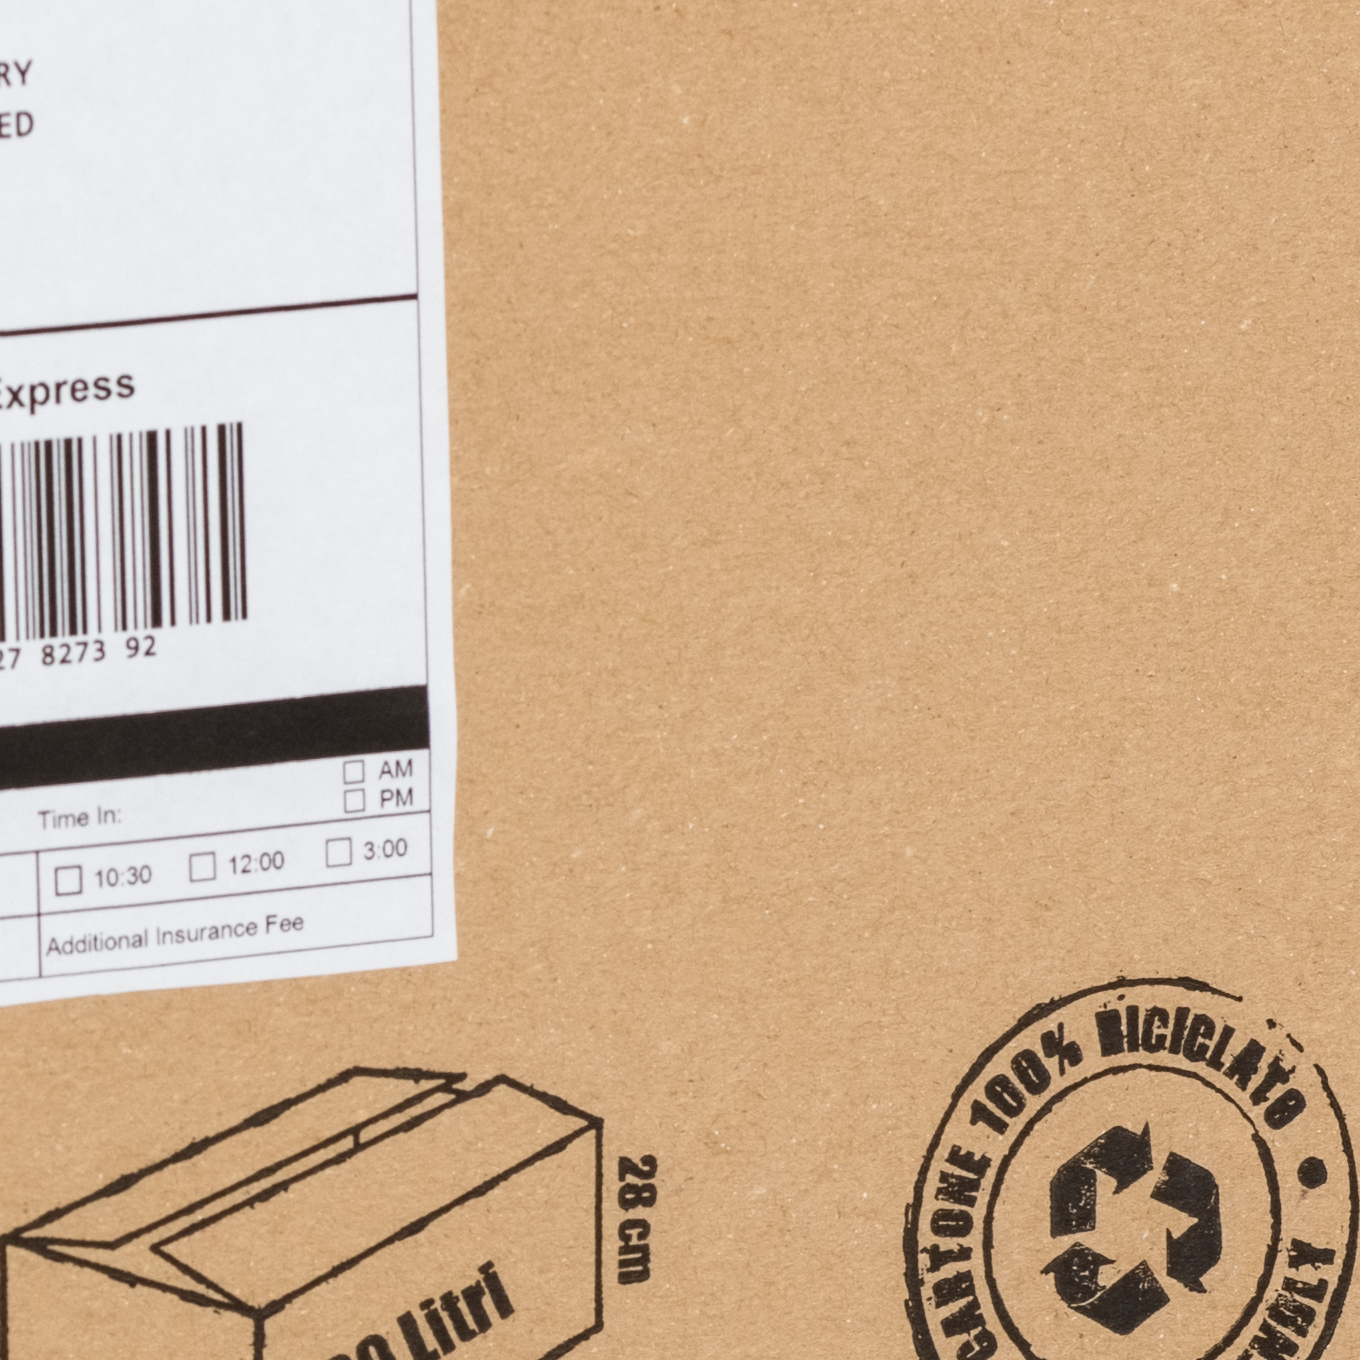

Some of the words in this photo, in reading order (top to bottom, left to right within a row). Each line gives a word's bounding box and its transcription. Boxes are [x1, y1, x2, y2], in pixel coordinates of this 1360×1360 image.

[40, 636, 106, 667] 8273
[125, 634, 157, 659] 92
[378, 758, 413, 779] AM
[380, 786, 415, 810] PM
[37, 809, 90, 829] Time
[97, 806, 121, 825] In:
[364, 837, 408, 861] 3:00
[229, 850, 285, 875] 12:00
[95, 864, 153, 888] 10:30
[46, 929, 148, 956] Additional
[156, 921, 258, 945] Insurance
[265, 914, 304, 934] Fee
[970, 1022, 1083, 1136] 100%
[617, 1153, 658, 1212] 28
[617, 1219, 652, 1286] cm
